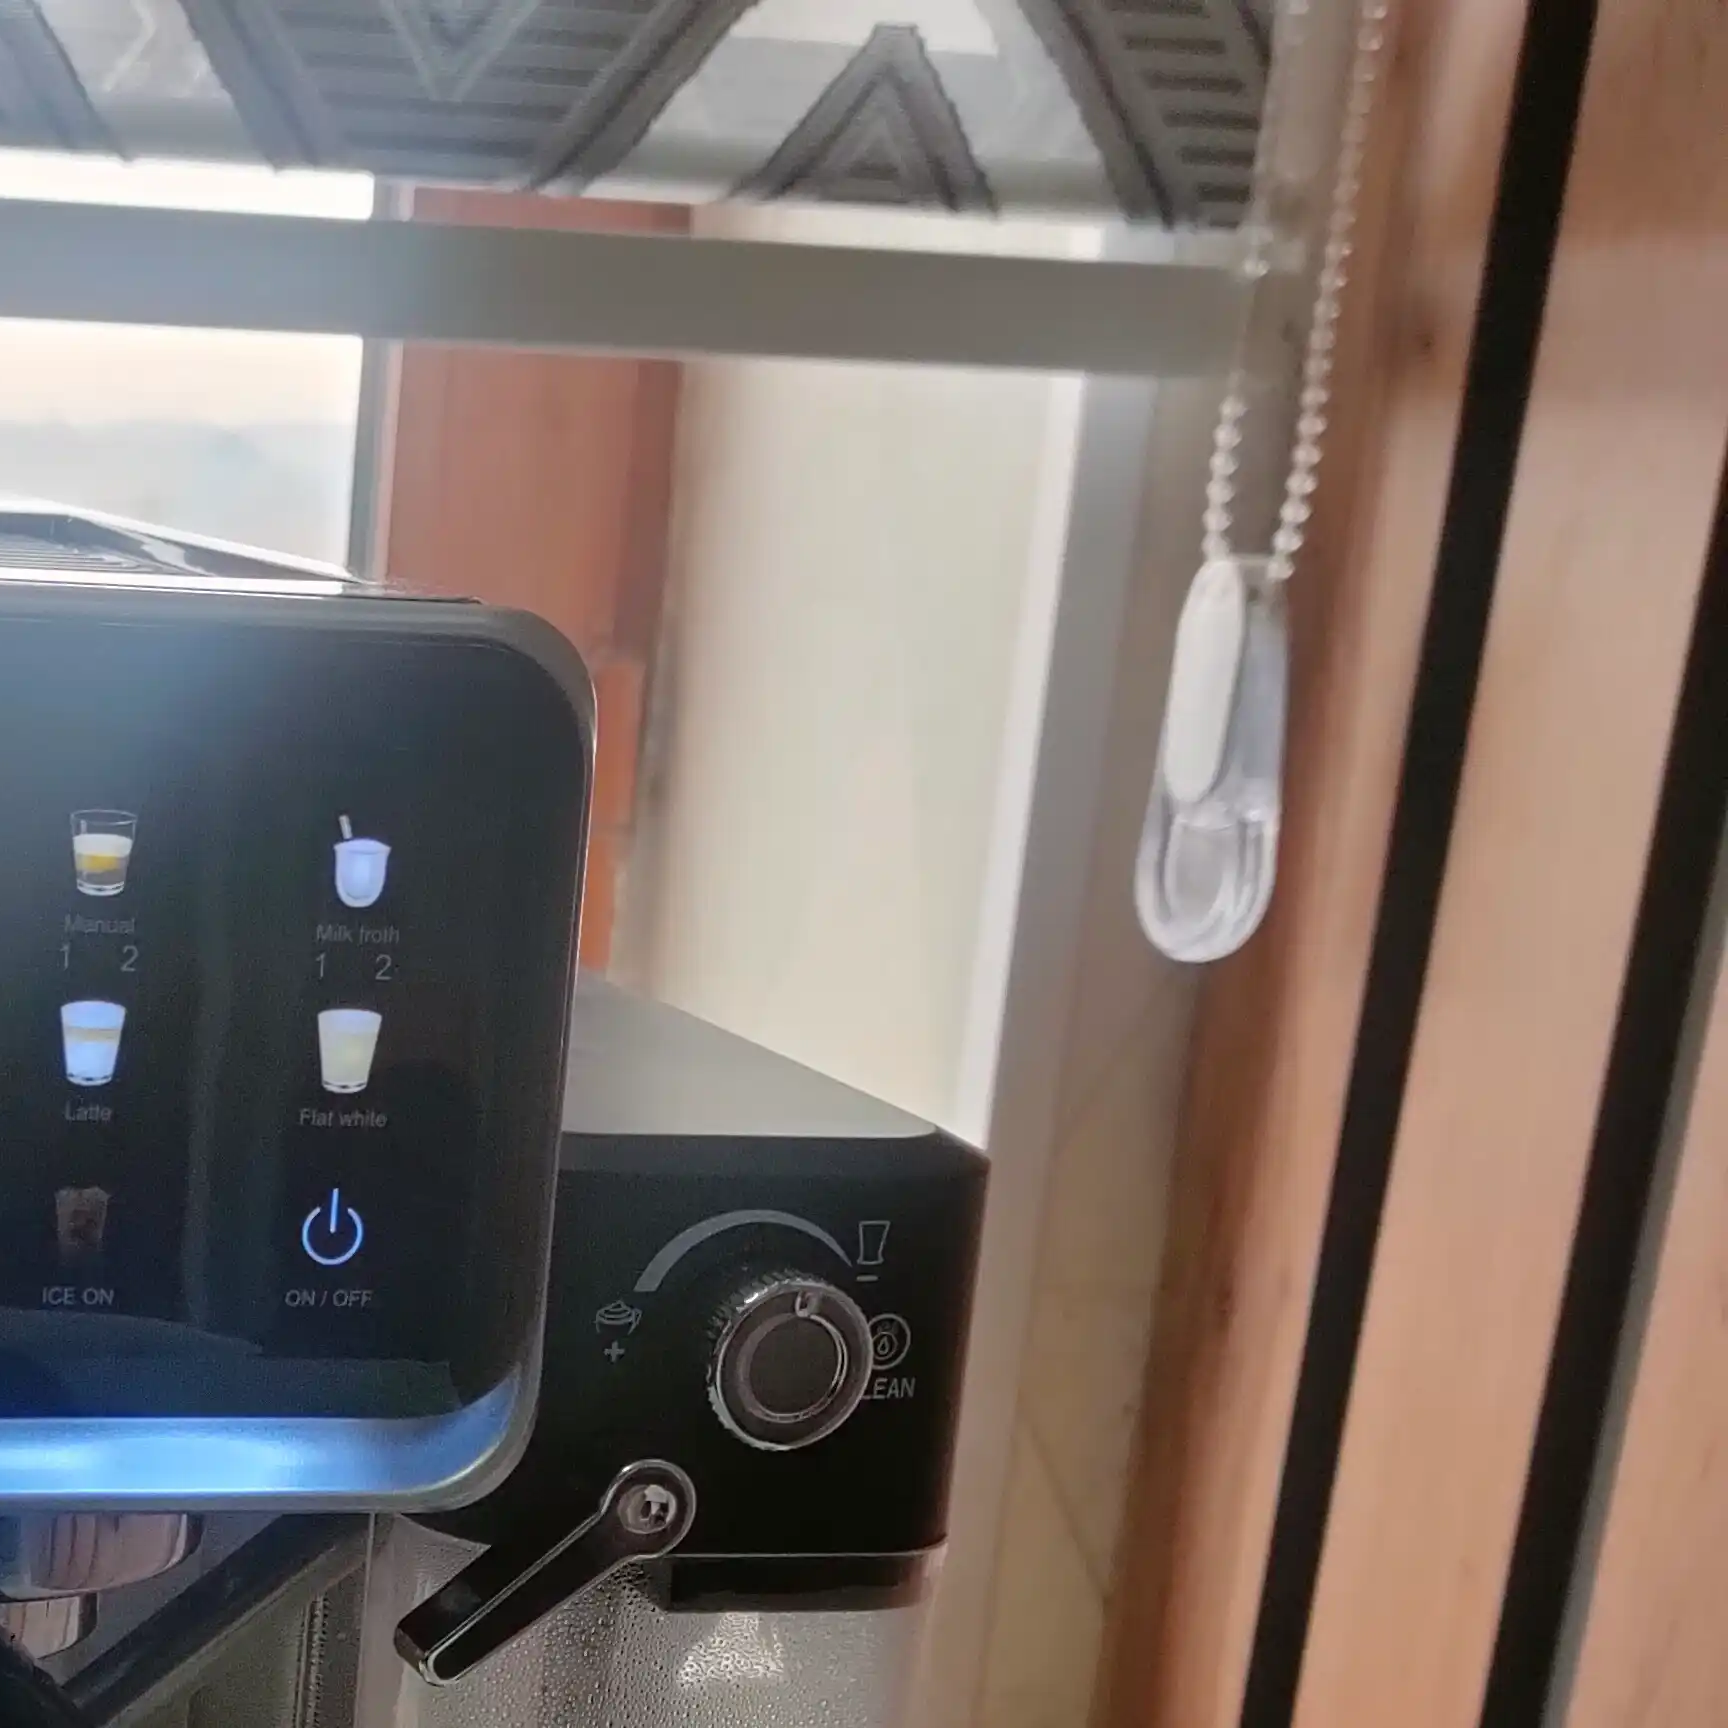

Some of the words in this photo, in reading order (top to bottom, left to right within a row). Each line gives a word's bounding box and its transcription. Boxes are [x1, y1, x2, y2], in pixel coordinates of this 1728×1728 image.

[64, 913, 135, 935] Manual
[316, 924, 353, 943] Milk
[358, 924, 400, 945] froth
[61, 943, 71, 970] 1
[119, 945, 140, 972] 2
[314, 952, 327, 980] 1
[375, 954, 393, 981] 2
[65, 1101, 113, 1122] Latte
[299, 1108, 334, 1127] Flat
[338, 1109, 388, 1128] white
[41, 1286, 75, 1305] ICE
[81, 1287, 115, 1305] ON
[284, 1289, 316, 1307] ON
[332, 1289, 374, 1307] OFF
